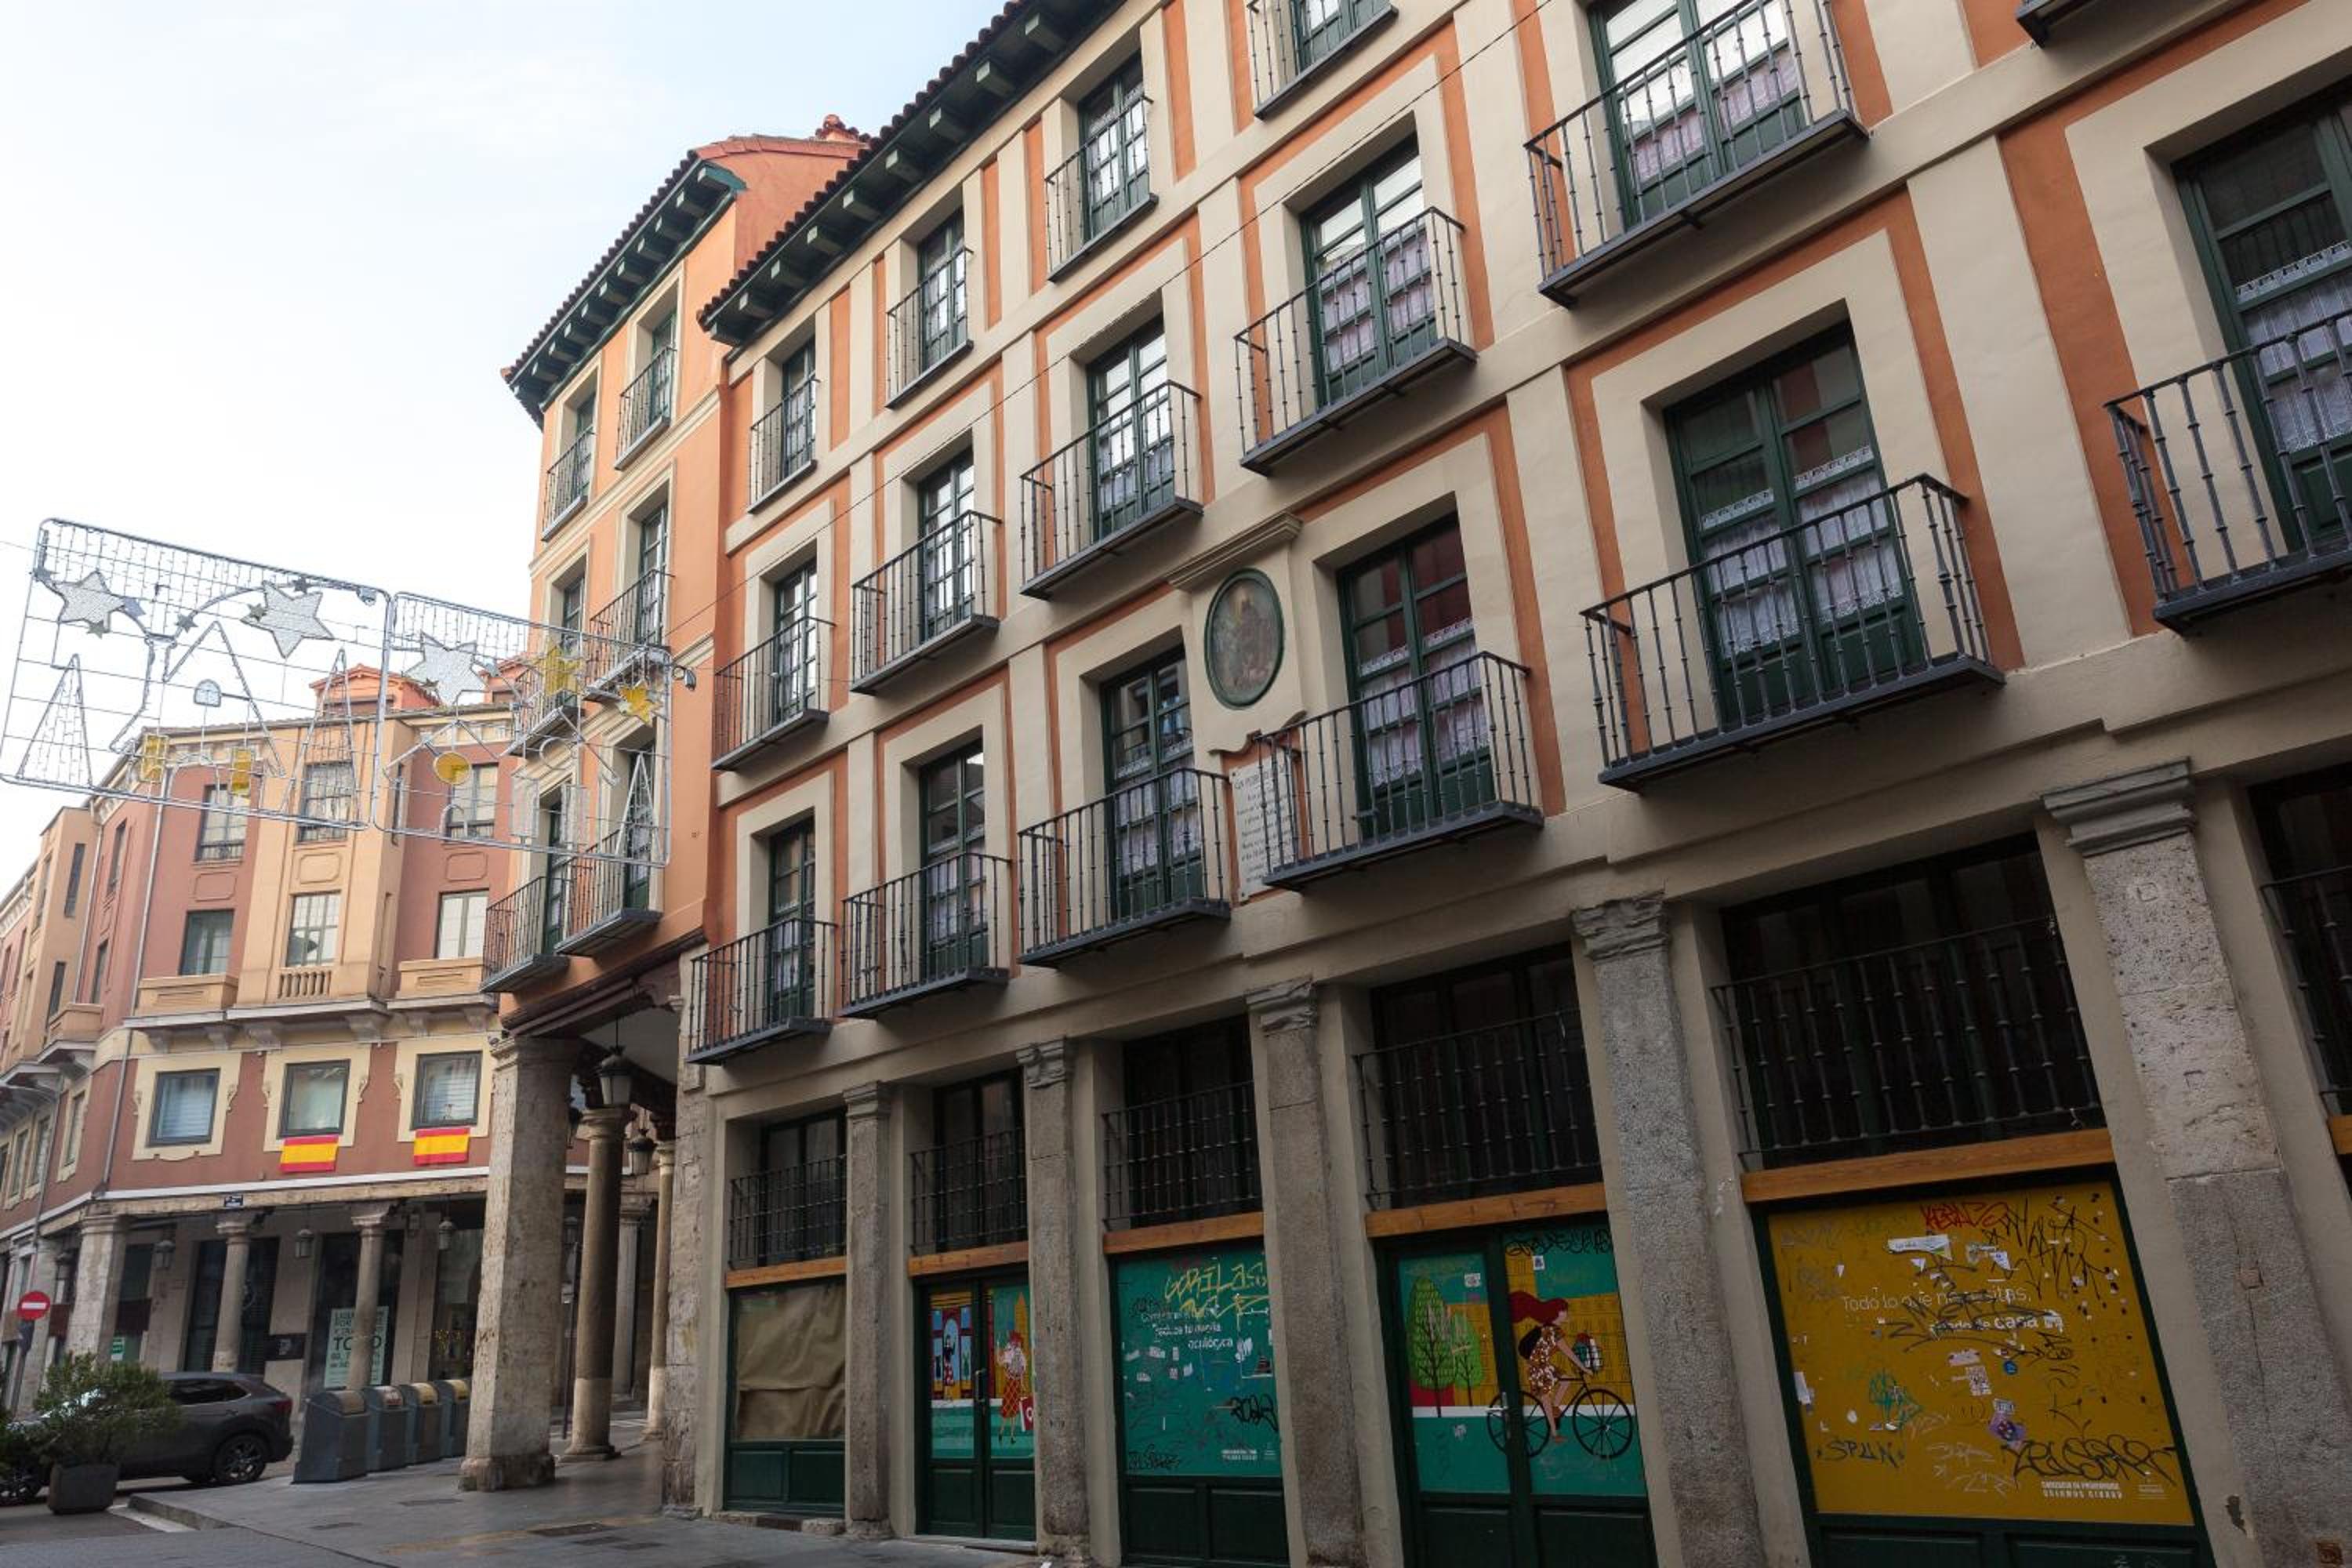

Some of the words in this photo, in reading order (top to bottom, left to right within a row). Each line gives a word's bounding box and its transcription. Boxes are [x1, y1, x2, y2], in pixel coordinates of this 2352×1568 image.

[1842, 1295, 1880, 1312] Todo
[1882, 1294, 1898, 1308] lo
[1900, 1294, 1933, 1310] que
[1994, 1316, 2038, 1330] casa
